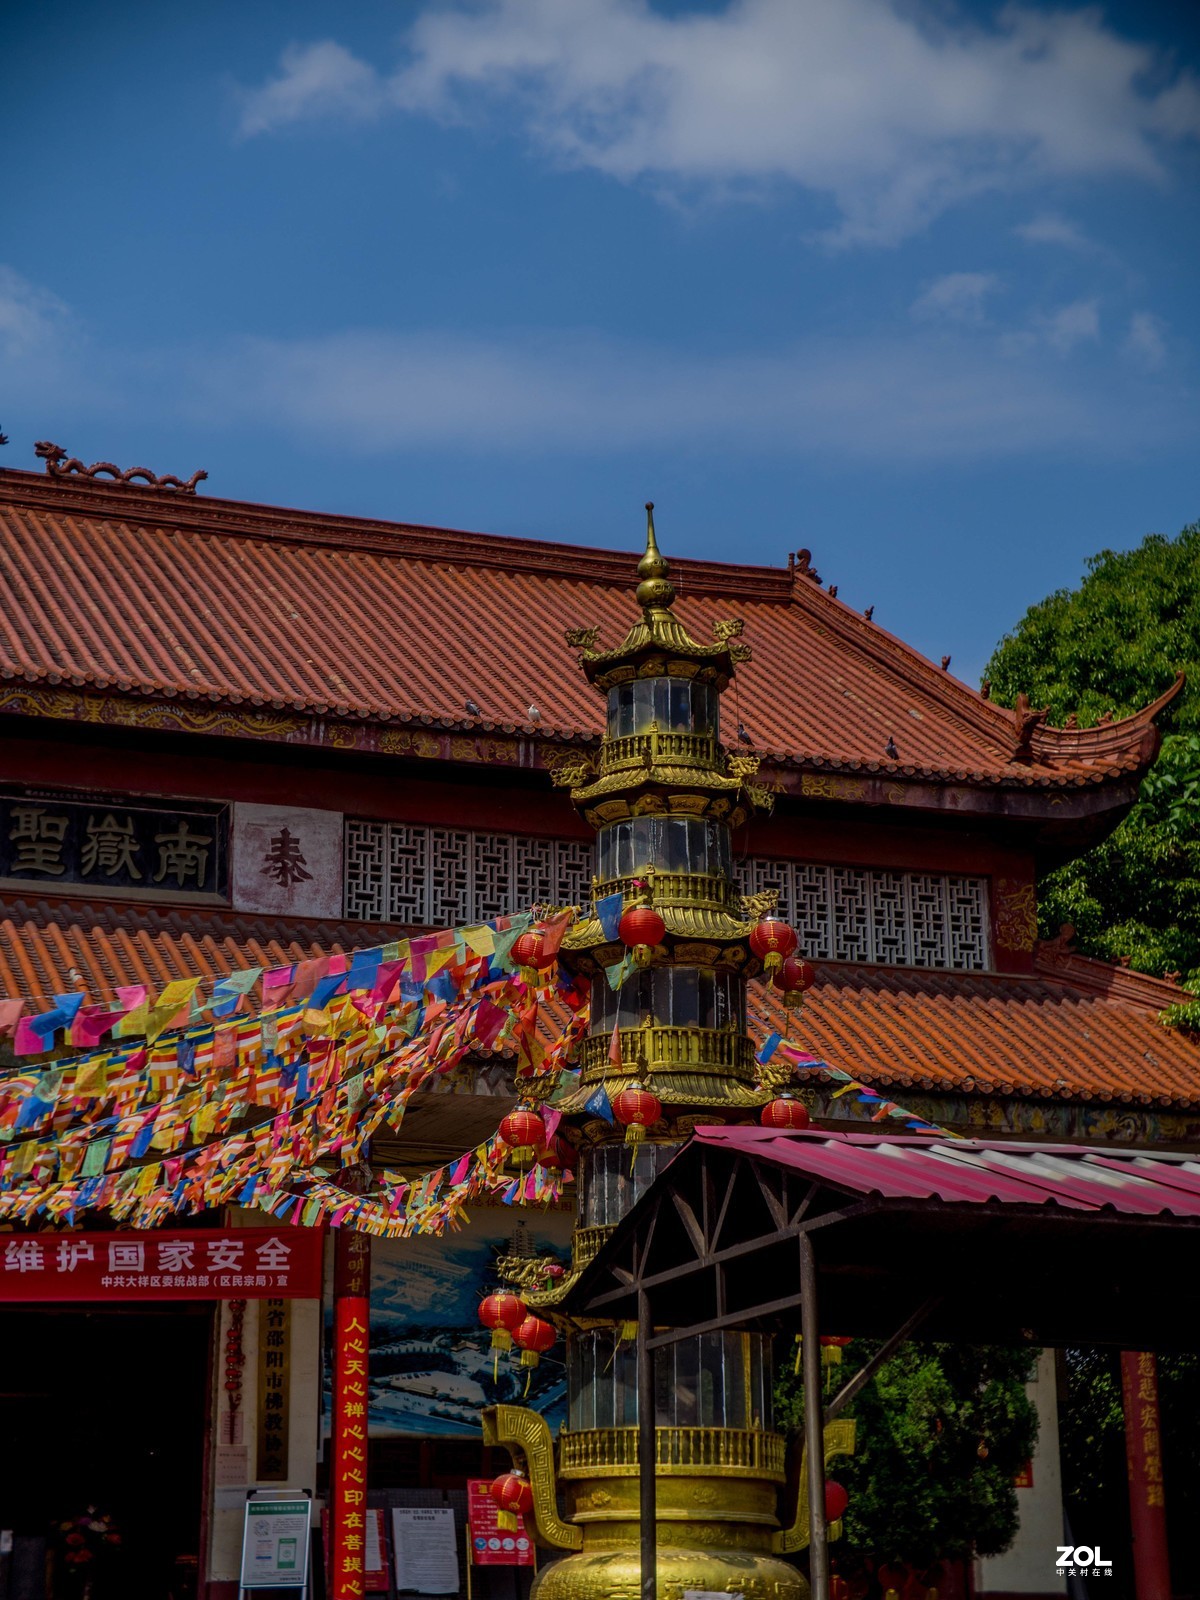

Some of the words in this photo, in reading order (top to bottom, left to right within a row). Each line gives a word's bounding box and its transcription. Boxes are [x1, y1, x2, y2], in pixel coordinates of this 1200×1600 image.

[259, 827, 314, 889] 泰
[4, 1237, 292, 1273] 维护国家安全
[341, 1317, 366, 1596] 人心天心禅心心心印在菩提心
